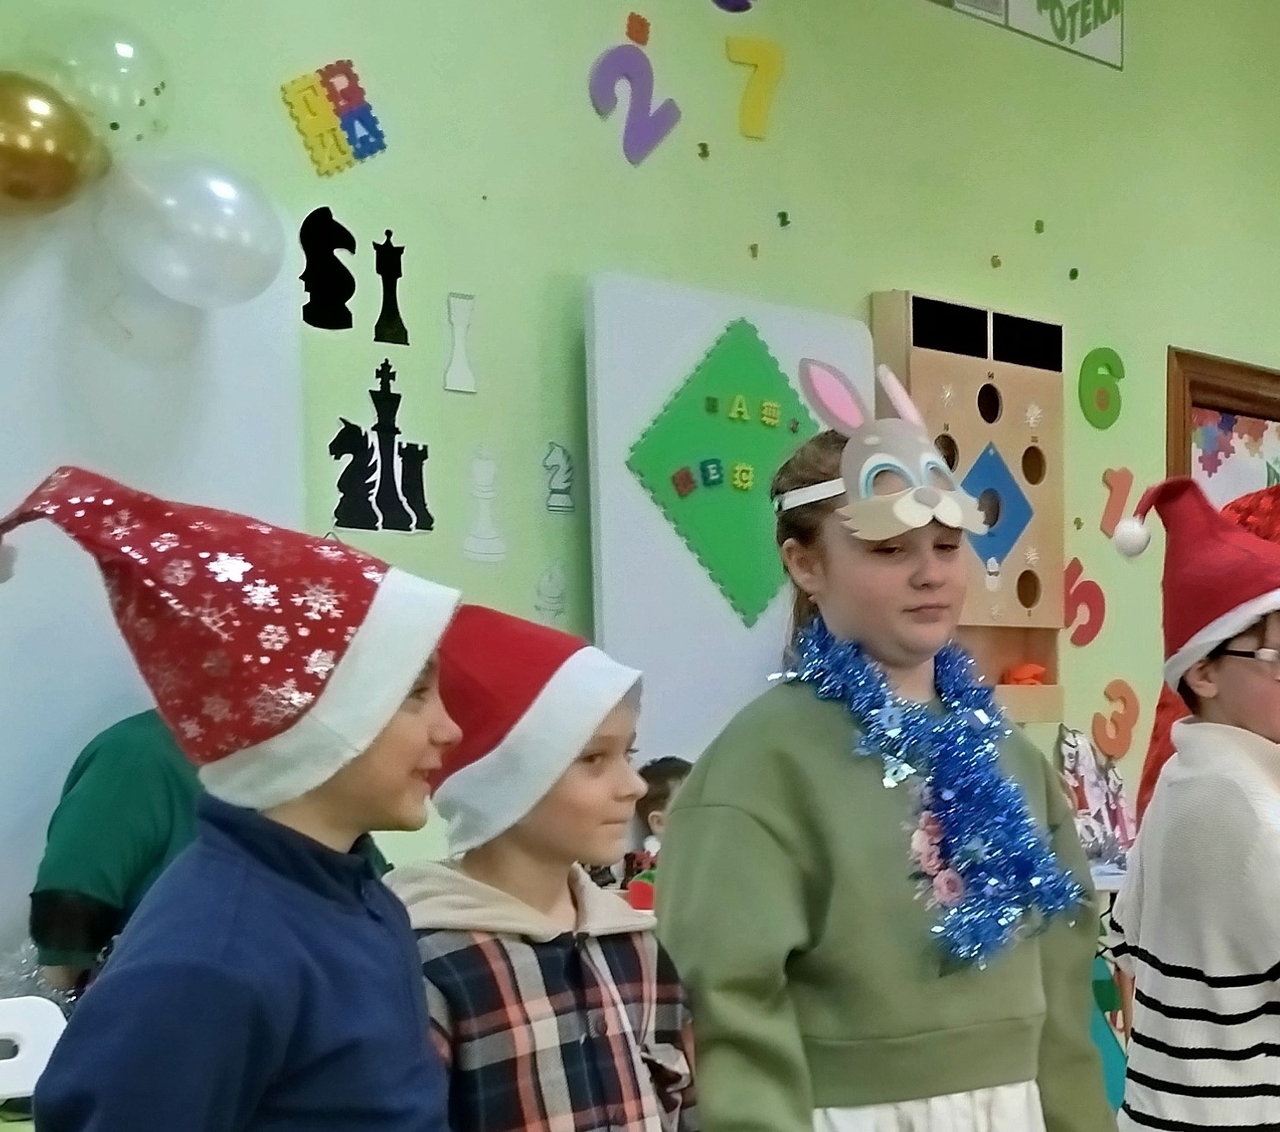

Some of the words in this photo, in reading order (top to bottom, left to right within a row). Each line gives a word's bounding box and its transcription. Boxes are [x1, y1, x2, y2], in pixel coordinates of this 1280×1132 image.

[589, 44, 682, 167] 2
[724, 35, 784, 140] 7
[697, 142, 710, 159] 3
[777, 211, 791, 228] 2
[1078, 347, 1125, 431] 6
[1100, 466, 1134, 540] 1
[1064, 556, 1106, 647] 5
[1092, 679, 1140, 759] 3
